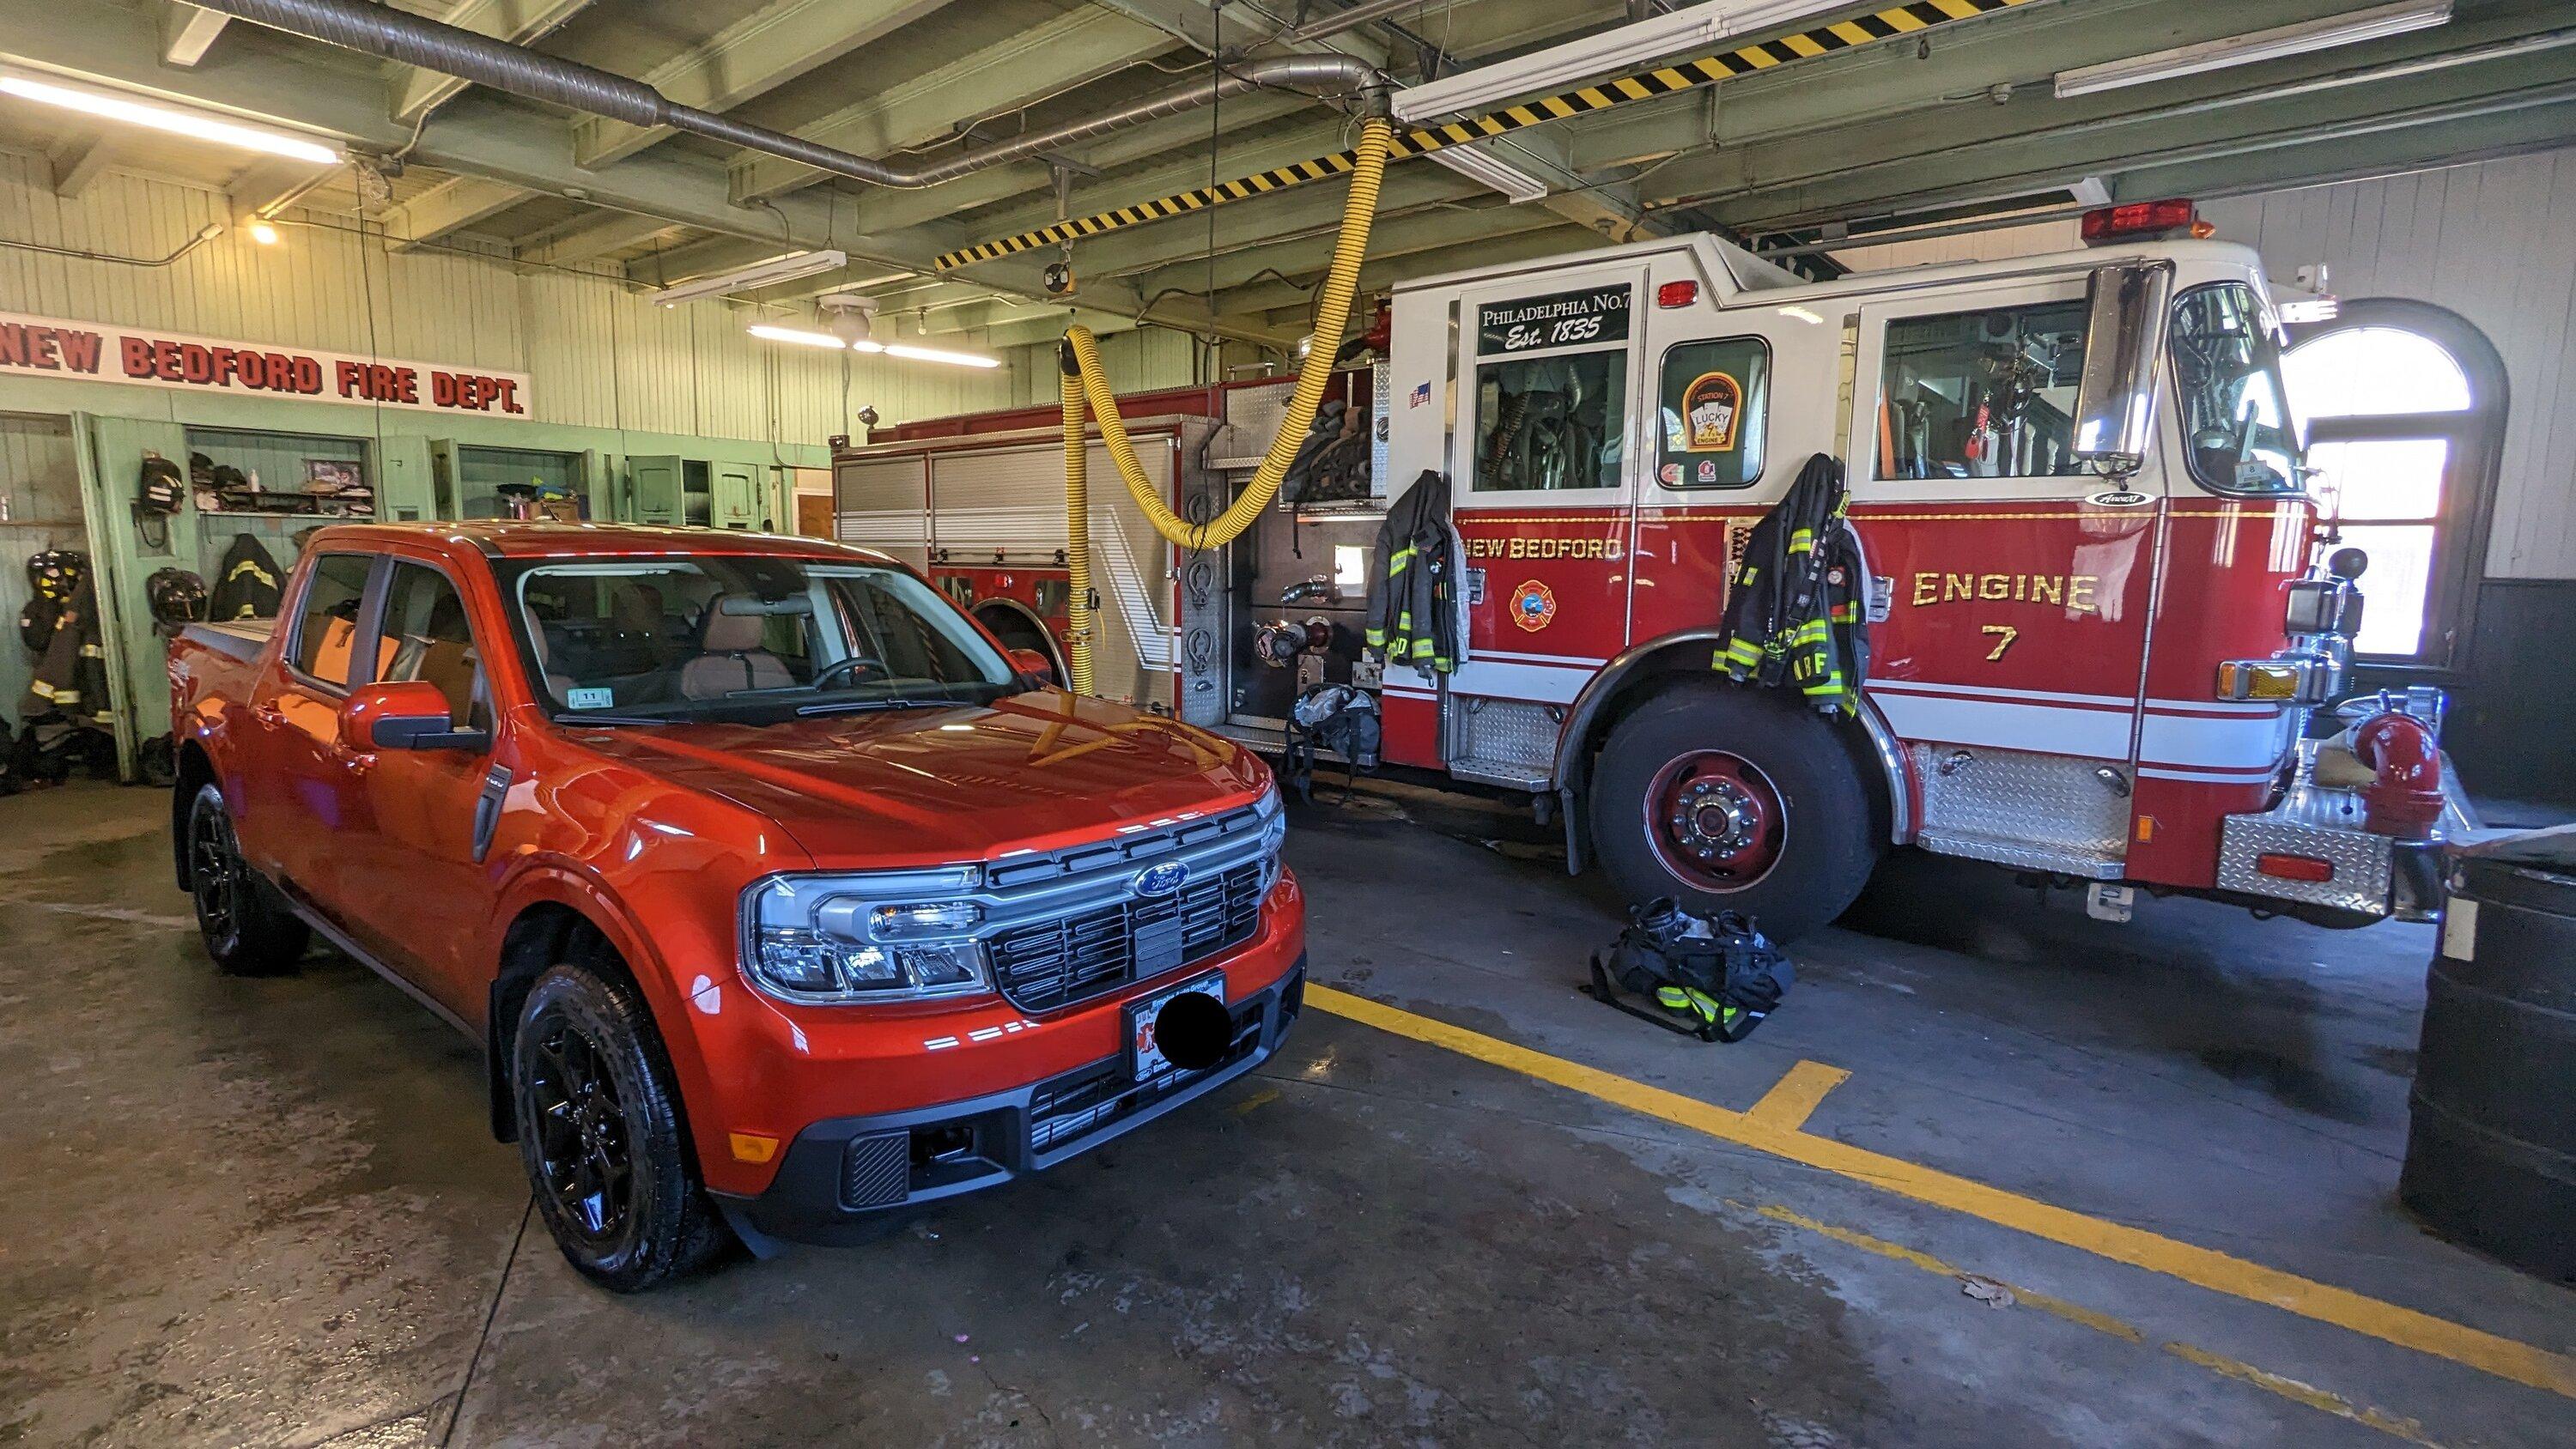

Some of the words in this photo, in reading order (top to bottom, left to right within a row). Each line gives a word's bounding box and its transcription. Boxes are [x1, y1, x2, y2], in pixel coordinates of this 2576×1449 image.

[1482, 300, 1589, 327] PHILADELPHIA
[1504, 324, 1542, 350] Est.
[1551, 316, 1602, 343] 1835
[0, 322, 103, 374] NEW
[119, 336, 324, 395] BEDFORD
[336, 361, 419, 404] FIRE
[431, 371, 524, 414] DEPT.
[1697, 391, 1723, 402] STATION
[1696, 413, 1728, 425] LUCKY
[1510, 537, 1623, 560] BEDFORD
[1912, 573, 2099, 612] ENGINE
[1982, 625, 2018, 661] 7
